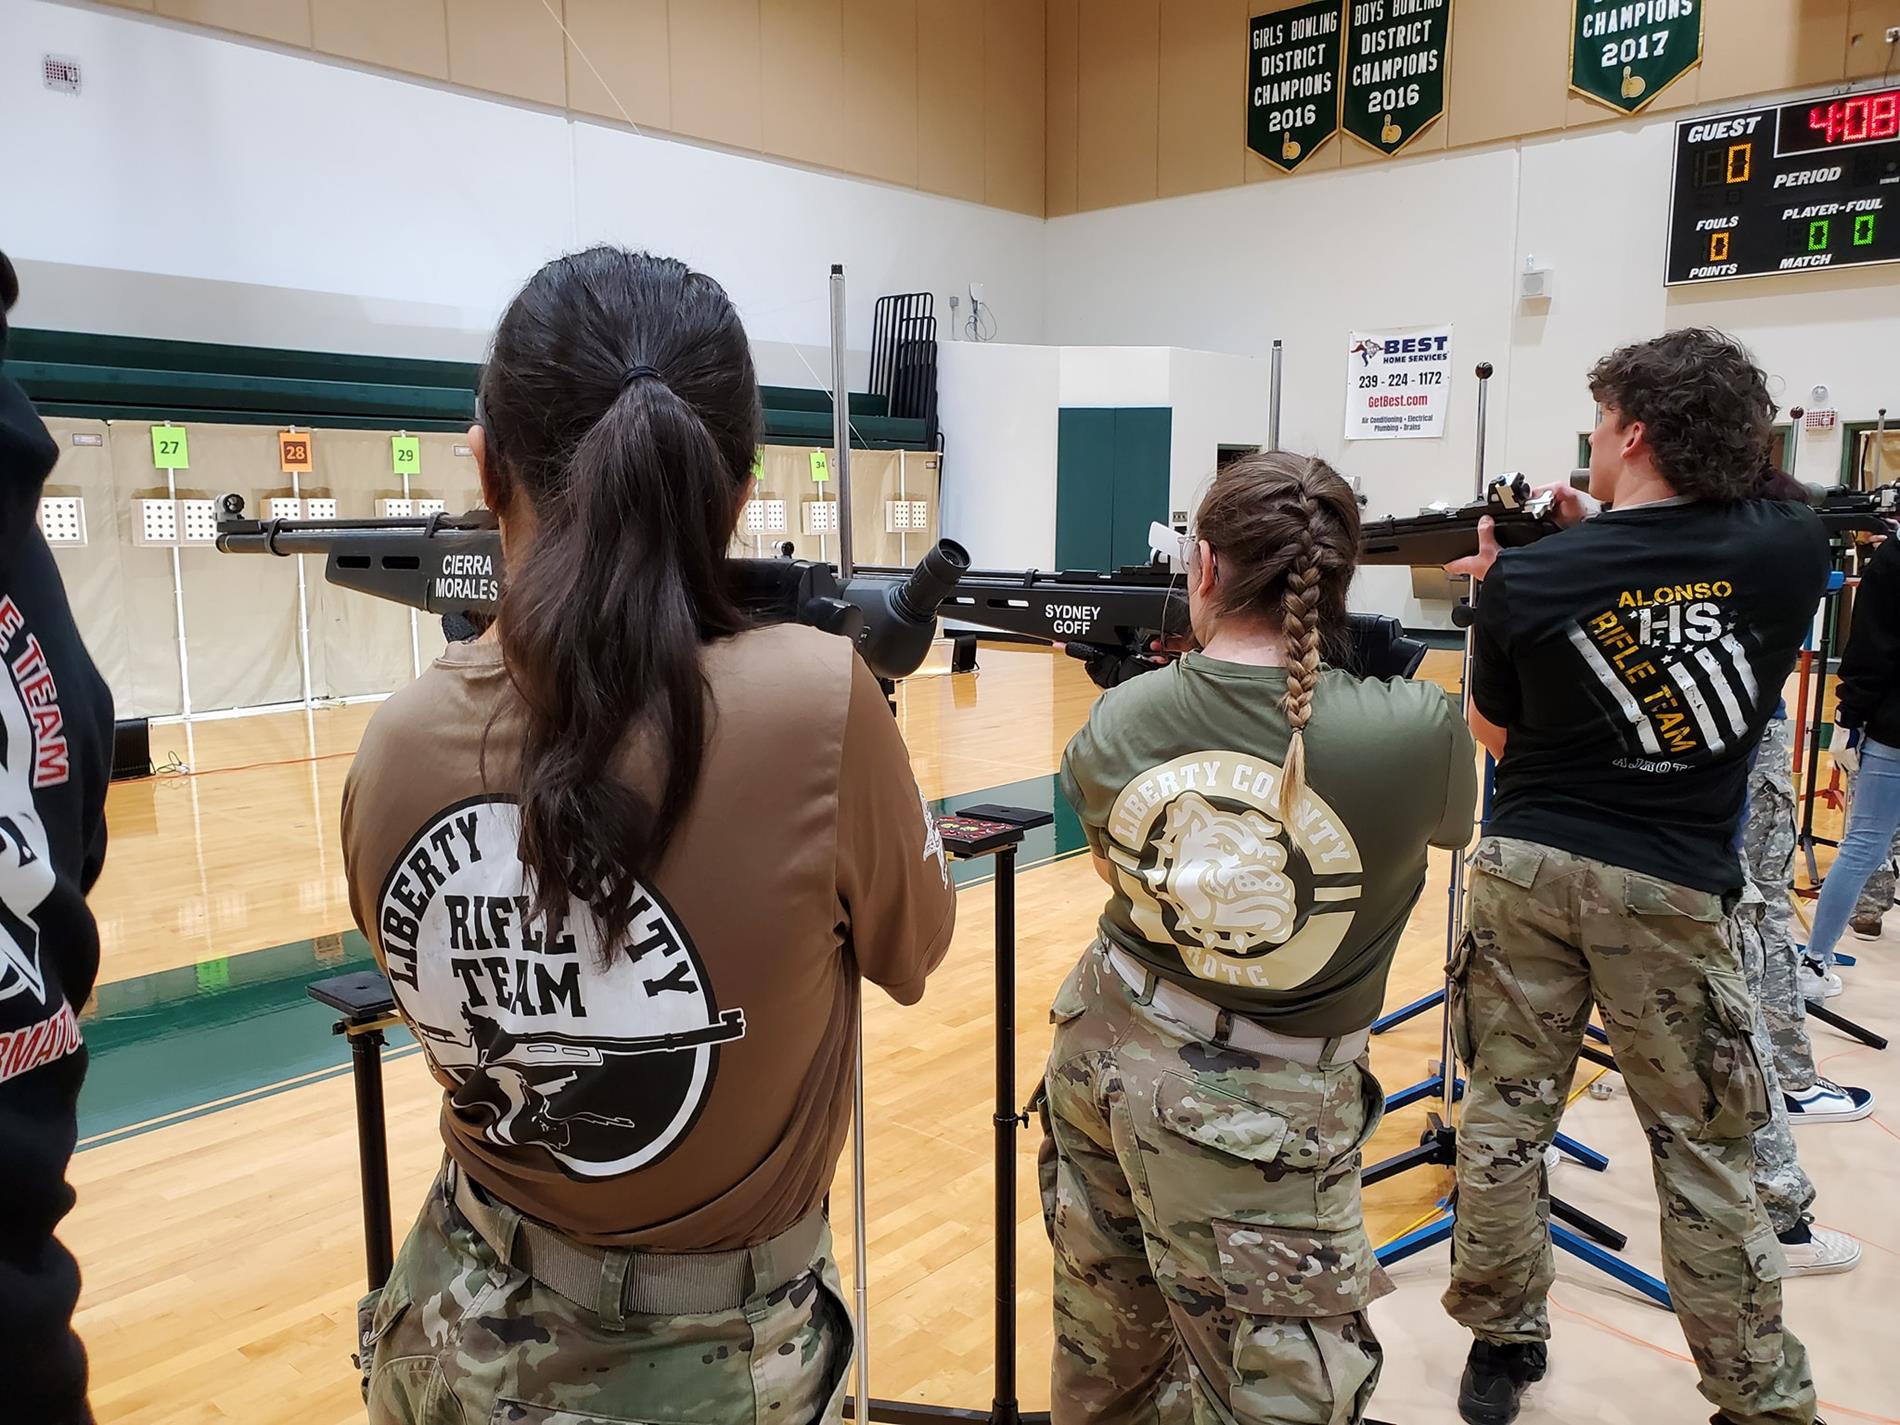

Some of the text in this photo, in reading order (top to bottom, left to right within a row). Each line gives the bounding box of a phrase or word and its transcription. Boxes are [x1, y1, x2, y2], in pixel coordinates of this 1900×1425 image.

[1354, 0, 1384, 26] BOYS
[1582, 0, 1692, 38] CHAMPIONS
[1253, 11, 1338, 50] GIRLS BOWLING
[1361, 19, 1432, 55] DISTRICT
[1261, 43, 1326, 77] DISTRICT
[1601, 30, 1669, 67] 2017
[1352, 49, 1438, 86] CHAMPIONS
[1254, 71, 1332, 107] CHAMPIONS
[1368, 83, 1420, 113] 2016
[1269, 104, 1316, 133] 2016
[1688, 116, 1762, 143] GUEST
[1810, 95, 1897, 143] 4:08
[1726, 144, 1752, 184] 0
[1773, 166, 1842, 189] PERIOD
[1695, 215, 1739, 231] FOULS
[1782, 198, 1883, 220] PLAYER-FOUL
[1808, 214, 1875, 250] 0 0
[1710, 231, 1729, 262] 0
[1688, 263, 1738, 279] POINTS
[1779, 254, 1832, 270] MATCH
[1383, 352, 1448, 364] HOME SERVICES
[1384, 336, 1448, 355] BEST
[1359, 375, 1378, 389] 239
[1388, 373, 1408, 387] 224
[1419, 371, 1442, 385] 1172
[1368, 394, 1428, 408] GetBest.com
[1374, 423, 1421, 432] Plumbing Drains
[1407, 414, 1433, 423] Electrical
[159, 440, 180, 455] 27
[285, 446, 306, 461] 28
[397, 449, 414, 462] 29
[442, 554, 493, 576] CIERRA
[435, 577, 499, 602] MORALES
[1618, 580, 1733, 609] ALONSO
[1045, 604, 1101, 621] SYDNEY
[1638, 601, 1722, 646] HS
[1053, 619, 1091, 635] GOFF
[1587, 609, 1698, 753] RIFLE TAM
[11, 631, 70, 789] TEAM
[1114, 760, 1351, 864] LIBERTY CONTY
[385, 811, 482, 993] LIBERTY
[450, 956, 588, 1018] TEAM
